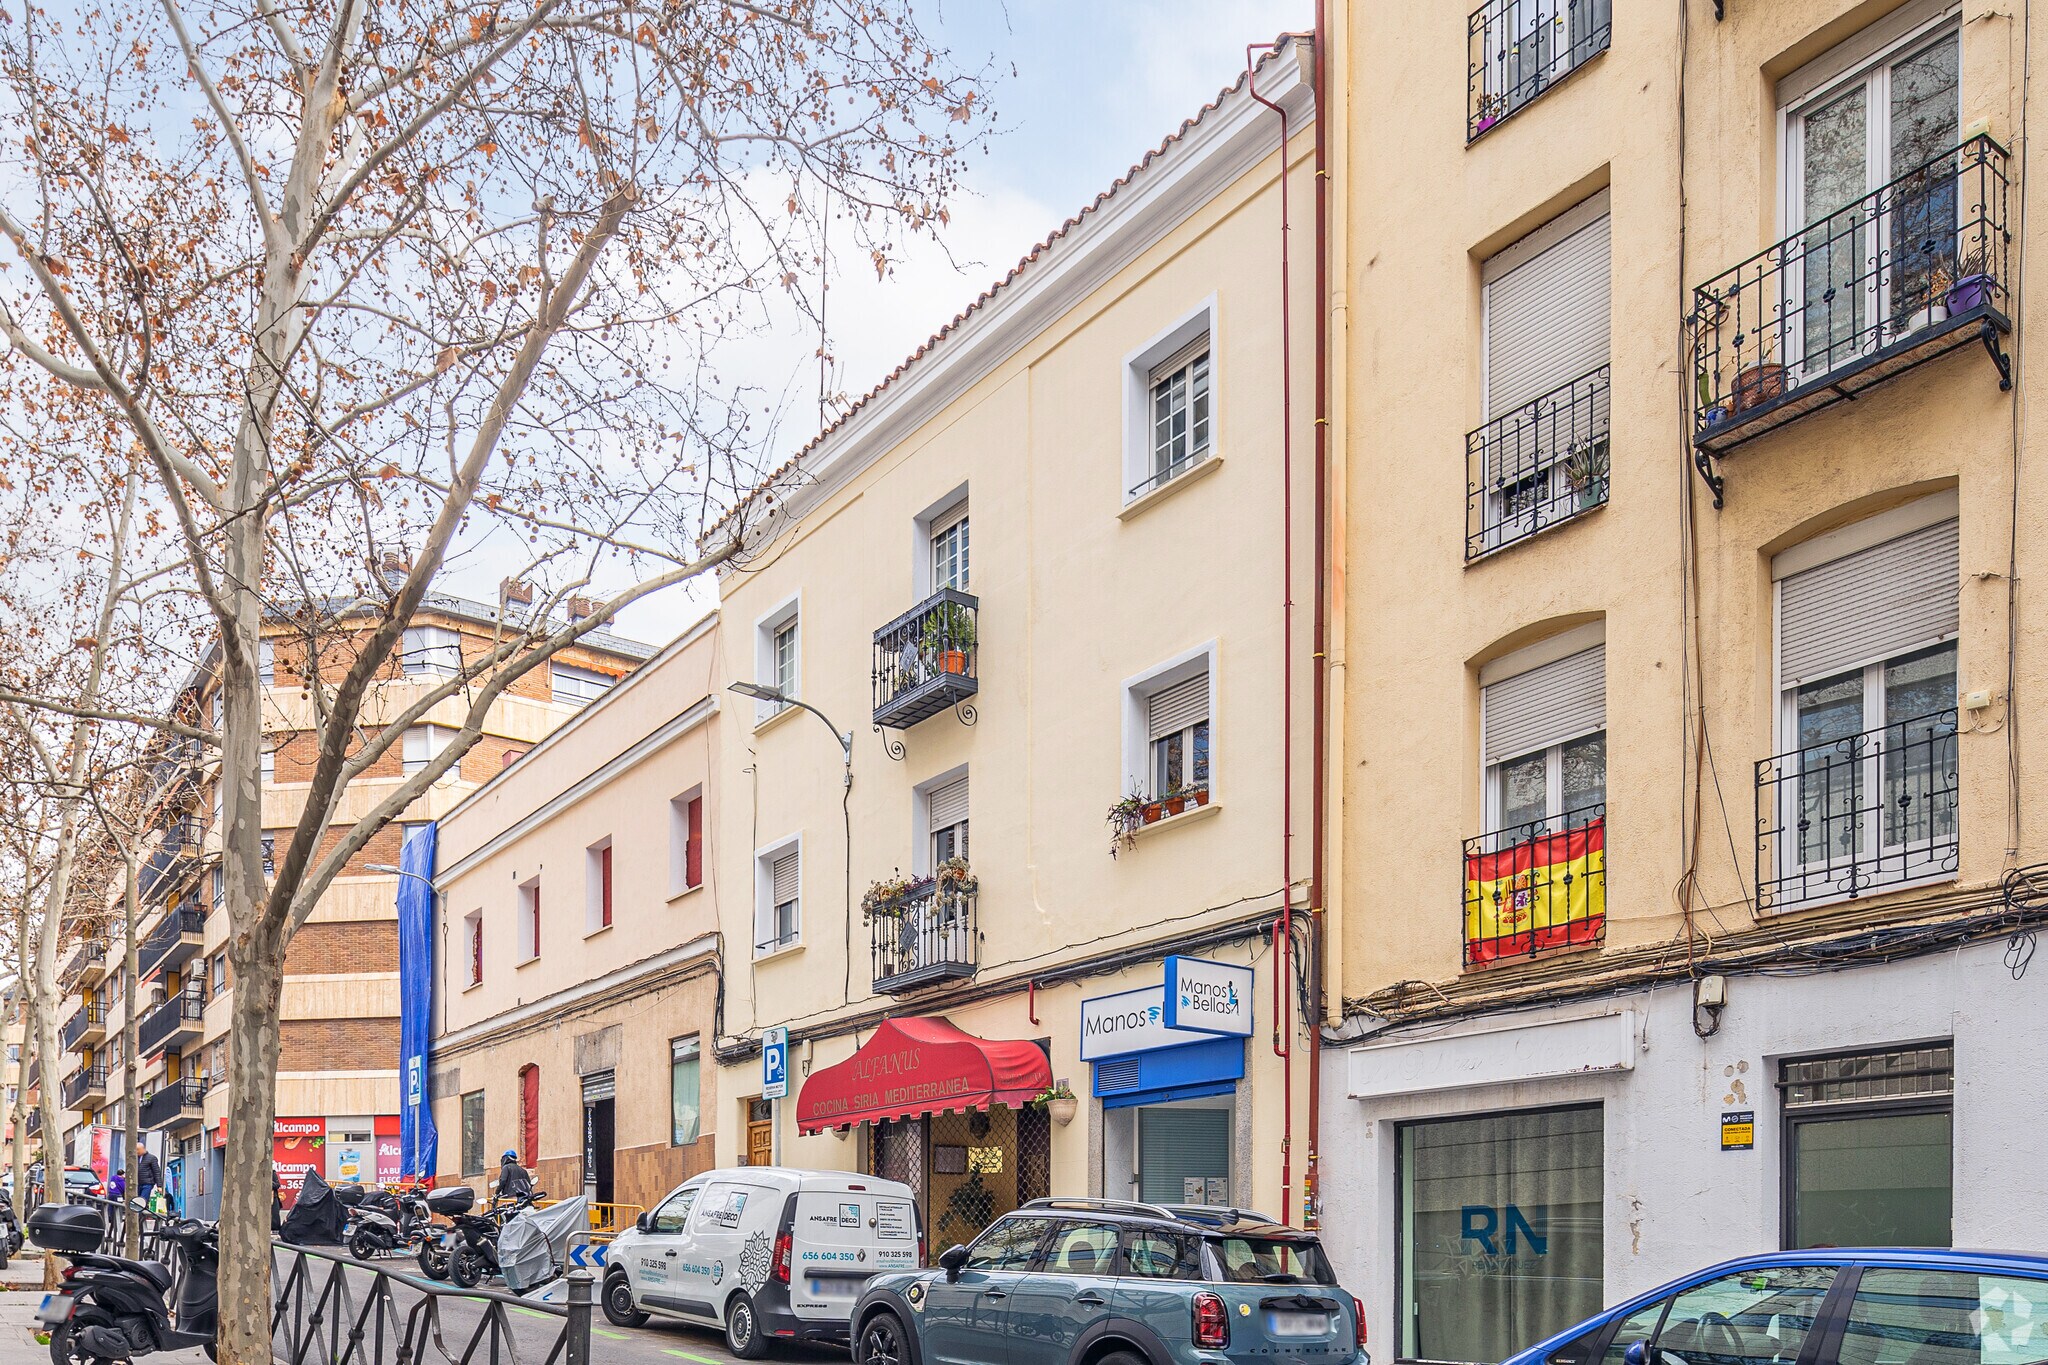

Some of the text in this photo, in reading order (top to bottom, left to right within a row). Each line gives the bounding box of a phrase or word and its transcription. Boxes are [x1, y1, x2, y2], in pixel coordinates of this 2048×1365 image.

[1181, 977, 1227, 998] Manos
[1193, 995, 1231, 1014] Bellas
[1085, 1010, 1147, 1037] Manos
[766, 1048, 780, 1081] P
[852, 1047, 921, 1082] ALFANUS
[812, 1077, 970, 1116] COCINA SIRIA MEDITERRANEA
[378, 1143, 402, 1156] Alc
[378, 1167, 389, 1175] LA
[286, 1180, 304, 1189] 365
[701, 1209, 738, 1221] ANSAFRE DECO
[1461, 1203, 1548, 1255] RN
[802, 1251, 855, 1261] 656 604 350
[878, 1250, 890, 1258] 910
[640, 1257, 667, 1271] 910 325 598
[682, 1263, 691, 1272] 656
[691, 1264, 700, 1274] 604
[700, 1266, 710, 1275] 350
